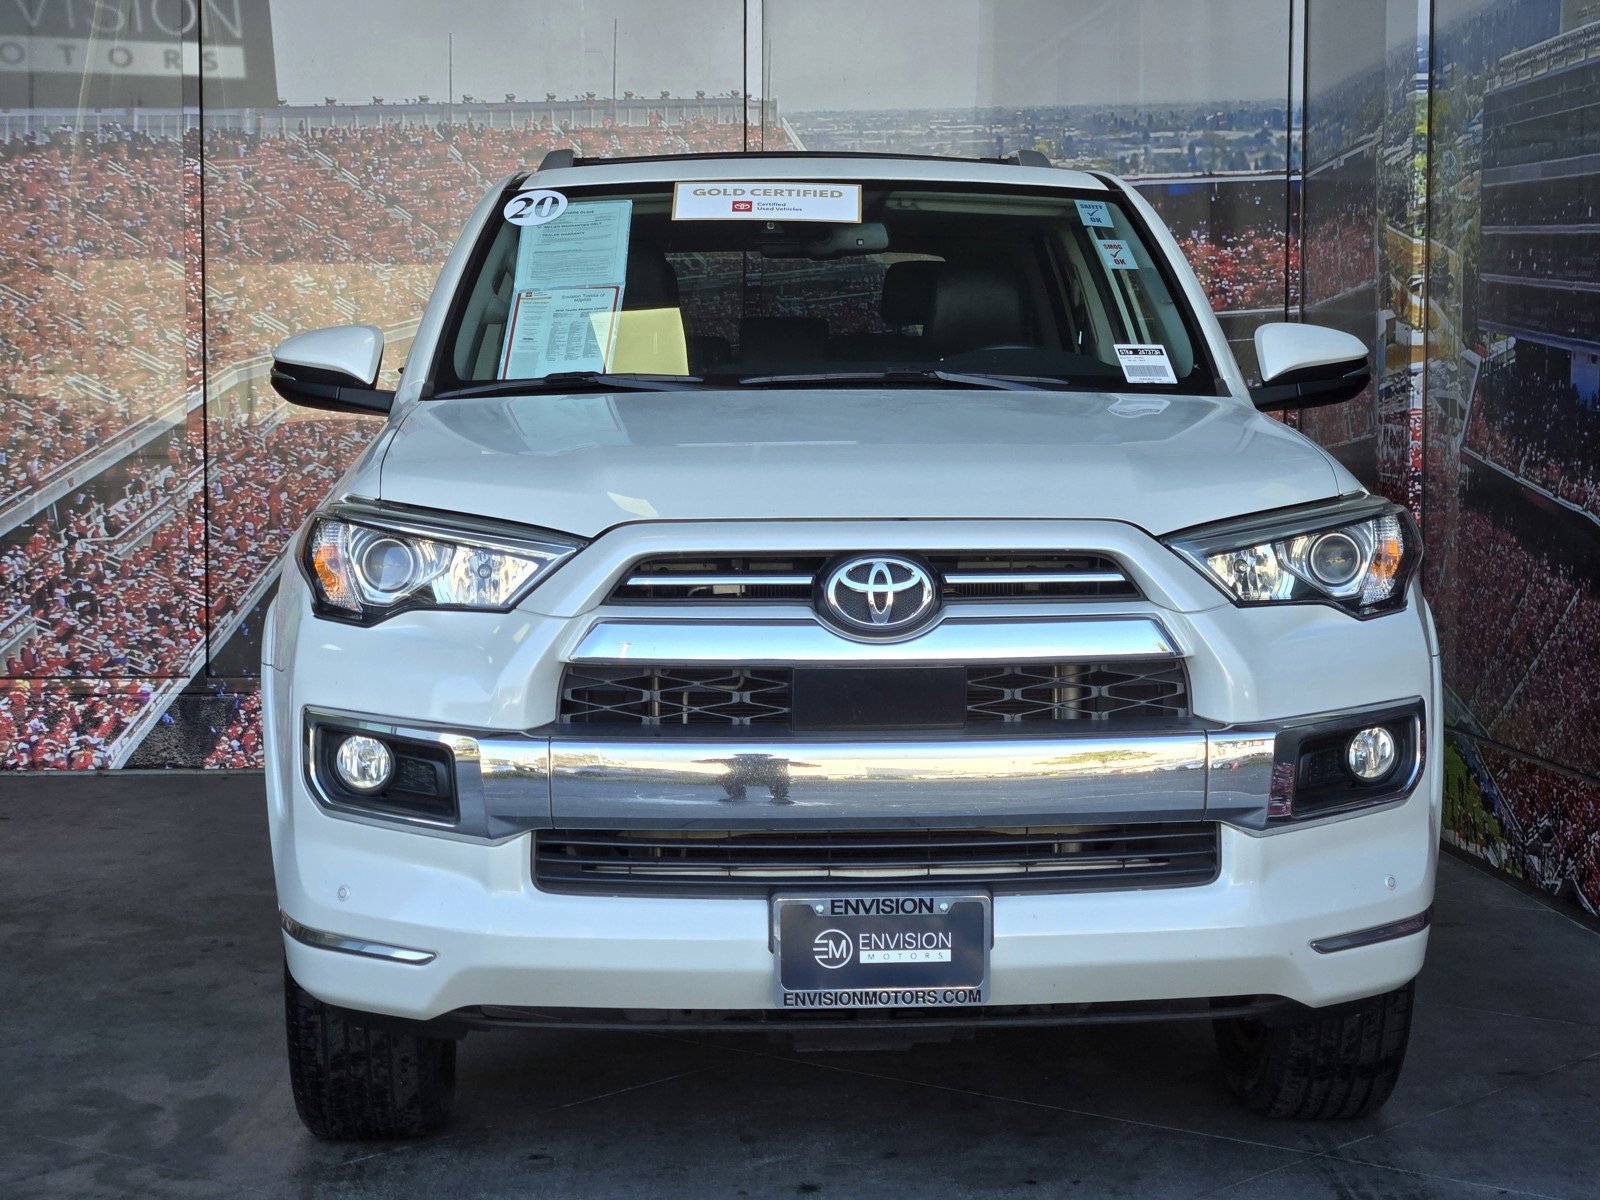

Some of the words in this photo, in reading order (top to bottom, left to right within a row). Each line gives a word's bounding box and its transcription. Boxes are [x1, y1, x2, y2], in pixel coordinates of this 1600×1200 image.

[693, 188, 746, 197] GOLD
[750, 188, 843, 198] CERTIFIED
[508, 195, 560, 220] 20
[830, 898, 934, 915] ENVISION
[859, 932, 952, 950] ENVISION
[867, 952, 944, 960] MOTORS
[783, 989, 982, 1007] ENVISIONMOTORS.COM
